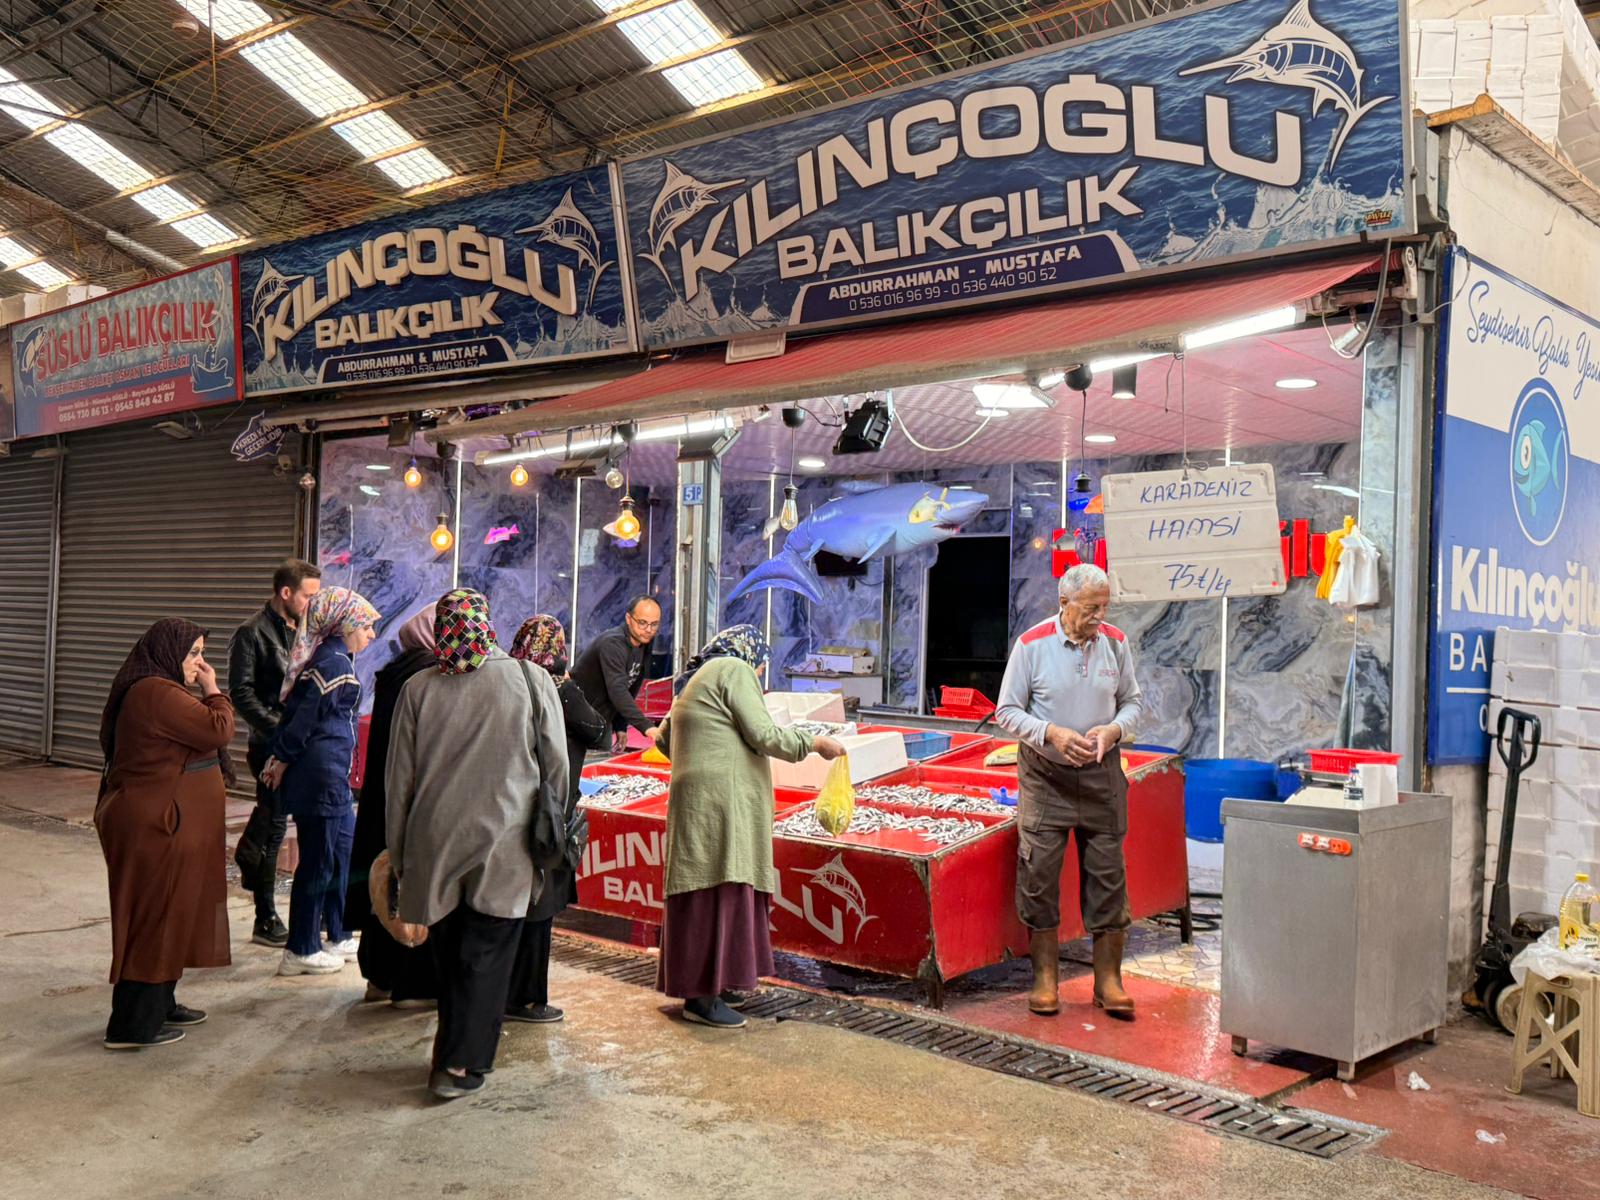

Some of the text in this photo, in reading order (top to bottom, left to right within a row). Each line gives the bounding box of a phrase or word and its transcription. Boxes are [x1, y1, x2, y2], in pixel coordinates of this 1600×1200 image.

[678, 74, 1301, 302] KILINÇOĞLU
[777, 165, 1144, 280] BALIKÇILIK
[264, 224, 577, 361] KILINÇOĞLU
[829, 266, 960, 300] ABDURRAHMAN
[985, 245, 1082, 275] MUSTAFA
[849, 299, 857, 312] 0
[859, 296, 882, 310] 536
[884, 293, 904, 306] 016
[906, 290, 923, 303] 96
[925, 287, 941, 300] 99
[951, 283, 960, 296] 0
[962, 278, 987, 293] 536
[990, 274, 1015, 289] 440
[1018, 270, 1037, 284] 90
[1039, 267, 1057, 281] 52
[36, 301, 217, 382] SÜSLÜ BALIKÇILIK
[315, 292, 504, 350] BALIKÇILIK
[1467, 280, 1530, 350] Seydişehir
[337, 345, 488, 373] ABDURRAHMAN & MUSTAFA
